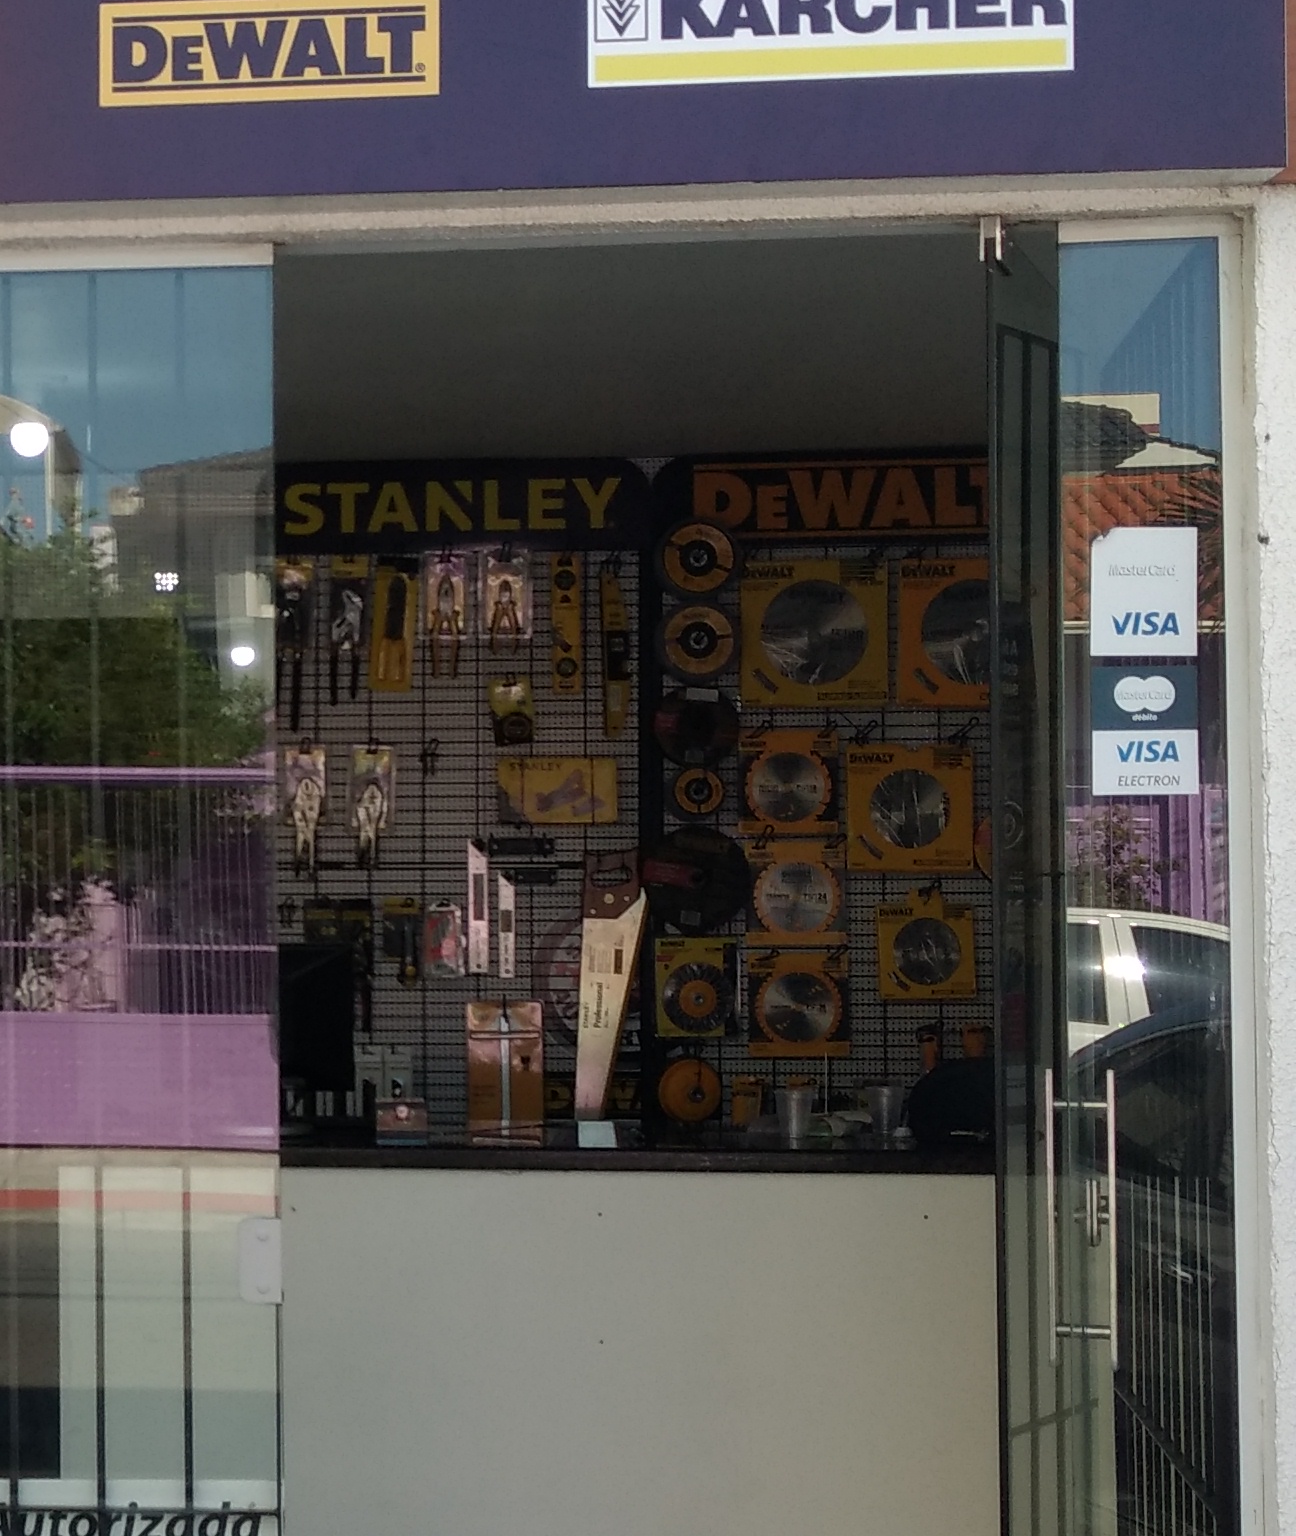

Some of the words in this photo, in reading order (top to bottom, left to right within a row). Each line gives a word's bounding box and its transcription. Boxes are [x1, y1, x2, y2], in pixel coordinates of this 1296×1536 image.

[283, 477, 622, 536] STANLEY
[1108, 564, 1176, 577] MasterCard
[1111, 611, 1180, 636] VISA
[1116, 740, 1180, 763] VISA
[1117, 774, 1181, 787] ELECTRON
